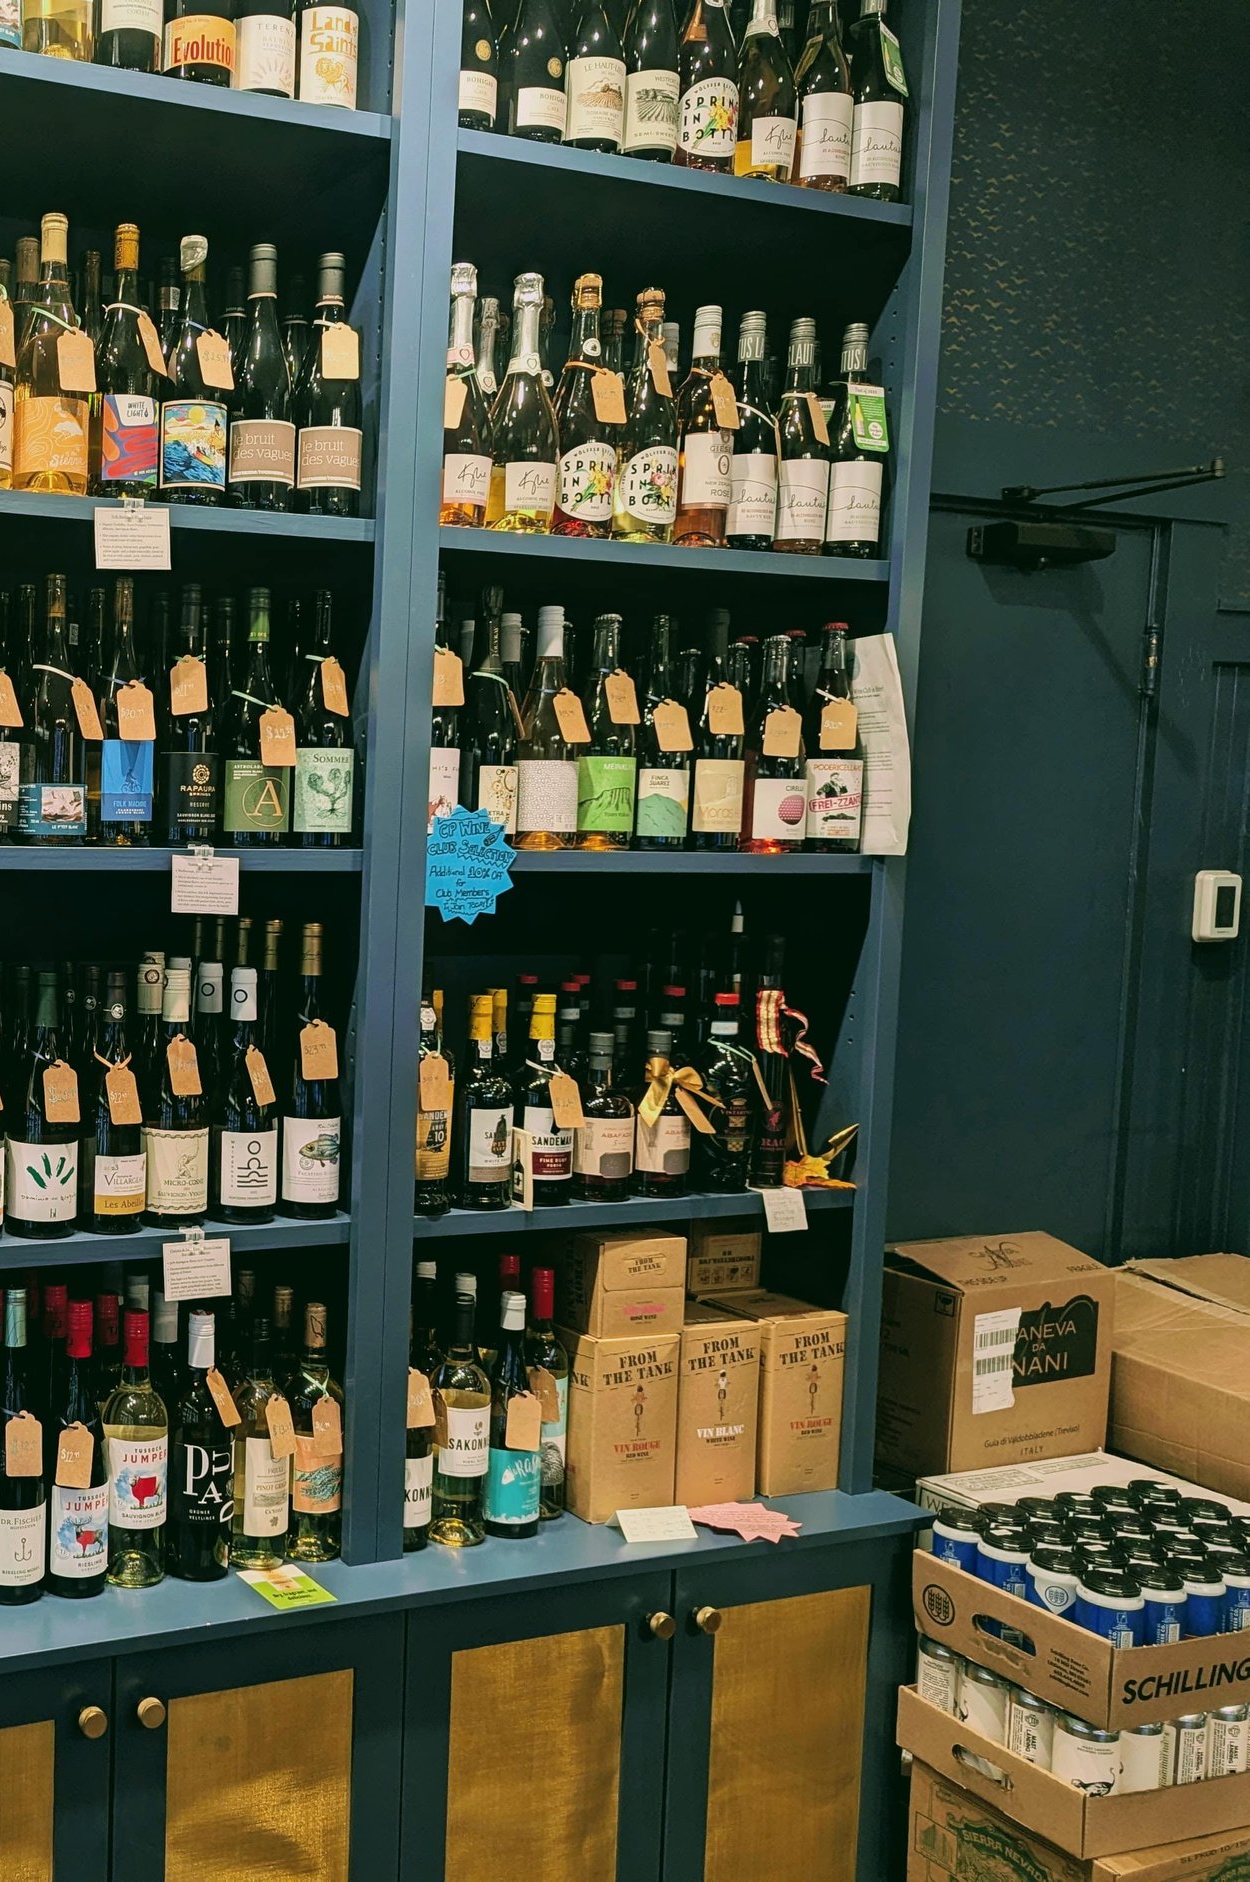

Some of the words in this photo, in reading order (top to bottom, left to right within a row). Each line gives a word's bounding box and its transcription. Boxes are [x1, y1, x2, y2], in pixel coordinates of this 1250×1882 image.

[684, 113, 700, 126] IN
[245, 433, 275, 446] bruit
[315, 439, 344, 453] bruit
[302, 454, 323, 466] des
[563, 477, 580, 488] IN
[439, 822, 457, 838] CP
[459, 821, 490, 837] WINE
[427, 842, 457, 855] CLUB
[468, 866, 490, 879] 10%
[456, 879, 466, 887] for
[434, 1131, 444, 1142] 10
[104, 1200, 118, 1208] Les
[703, 1338, 739, 1353] FROM
[795, 1332, 830, 1348] FROM
[1032, 1343, 1046, 1352] DA
[619, 1352, 657, 1369] FROM
[688, 1355, 717, 1370] THE
[720, 1348, 754, 1364] TANK
[779, 1350, 807, 1365] THE
[603, 1370, 636, 1385] THE
[639, 1362, 672, 1380] TANK
[790, 1421, 805, 1430] VIN
[807, 1418, 833, 1428] ROUGE
[697, 1428, 713, 1438] VIN
[715, 1425, 744, 1436] BLANC
[614, 1444, 630, 1452] VIN
[631, 1441, 660, 1451] ROUGE
[1020, 1445, 1044, 1456] ITALY
[1122, 1656, 1250, 1705] SCHILLING
[961, 1829, 1002, 1852] SIERRA
